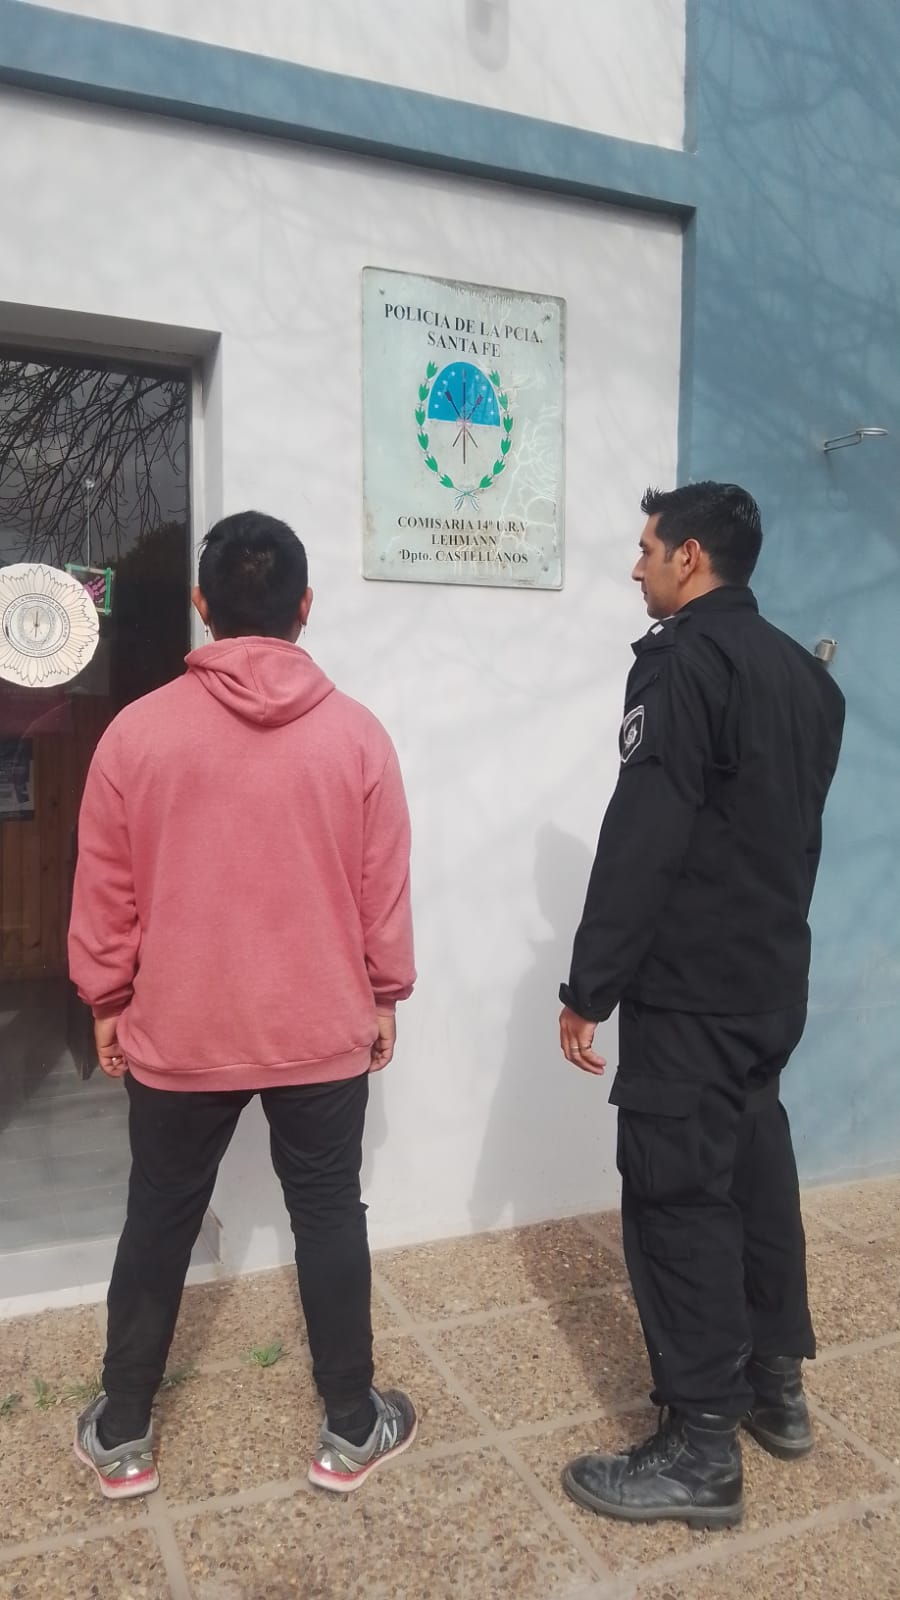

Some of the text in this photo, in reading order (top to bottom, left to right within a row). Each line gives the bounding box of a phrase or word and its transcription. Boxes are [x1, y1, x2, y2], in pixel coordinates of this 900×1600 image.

[384, 303, 543, 343] POLICIA DE LA PCIA.
[427, 330, 501, 358] SANTA FE
[397, 515, 473, 531] COMISARIA
[431, 534, 496, 546] LEHMANN
[401, 549, 528, 564] Dpto. CASTELLANOS
